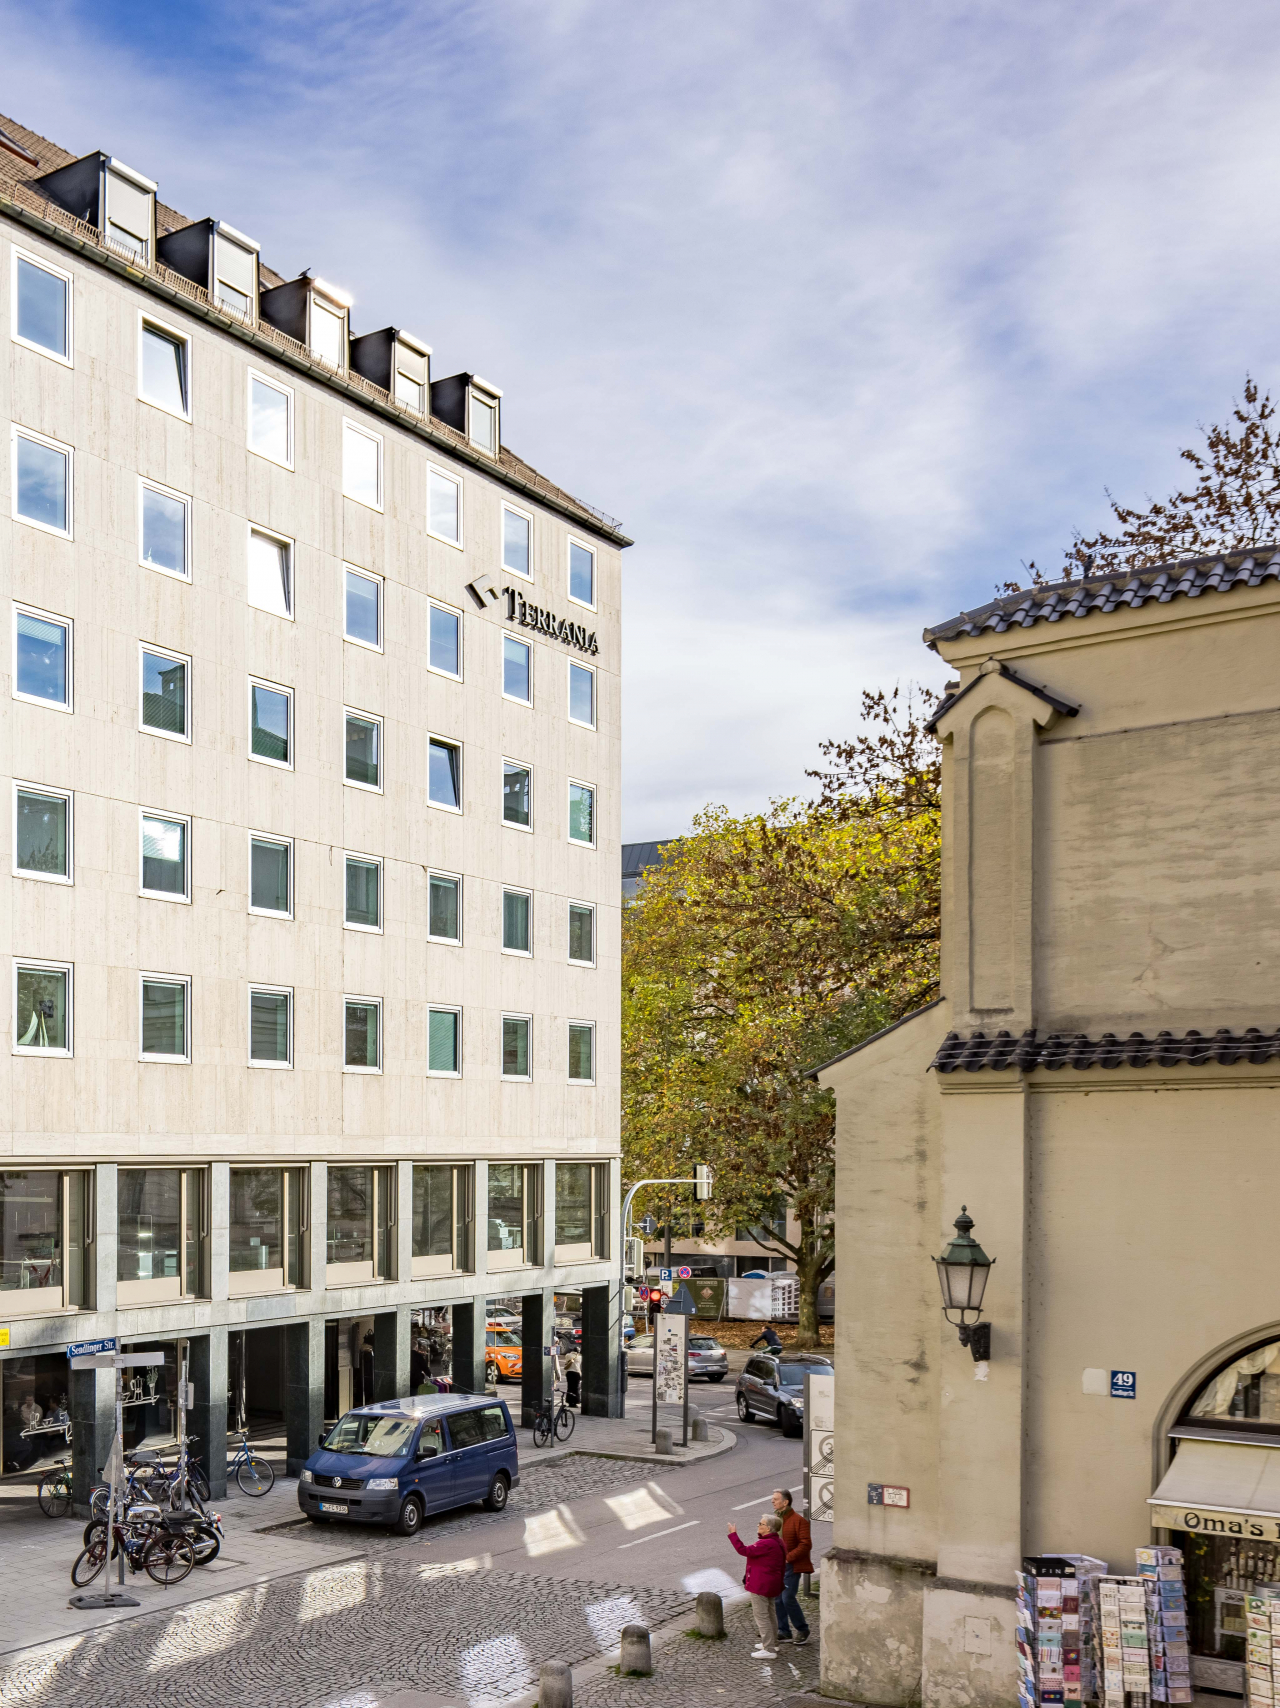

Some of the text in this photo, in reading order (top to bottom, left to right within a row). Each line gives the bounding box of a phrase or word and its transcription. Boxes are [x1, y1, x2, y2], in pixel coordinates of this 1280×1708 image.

[501, 586, 600, 656] TERRANA
[71, 1340, 115, 1356] Sendlinger Str.
[1113, 1373, 1134, 1386] 49
[1184, 1512, 1264, 1537] Oma's
